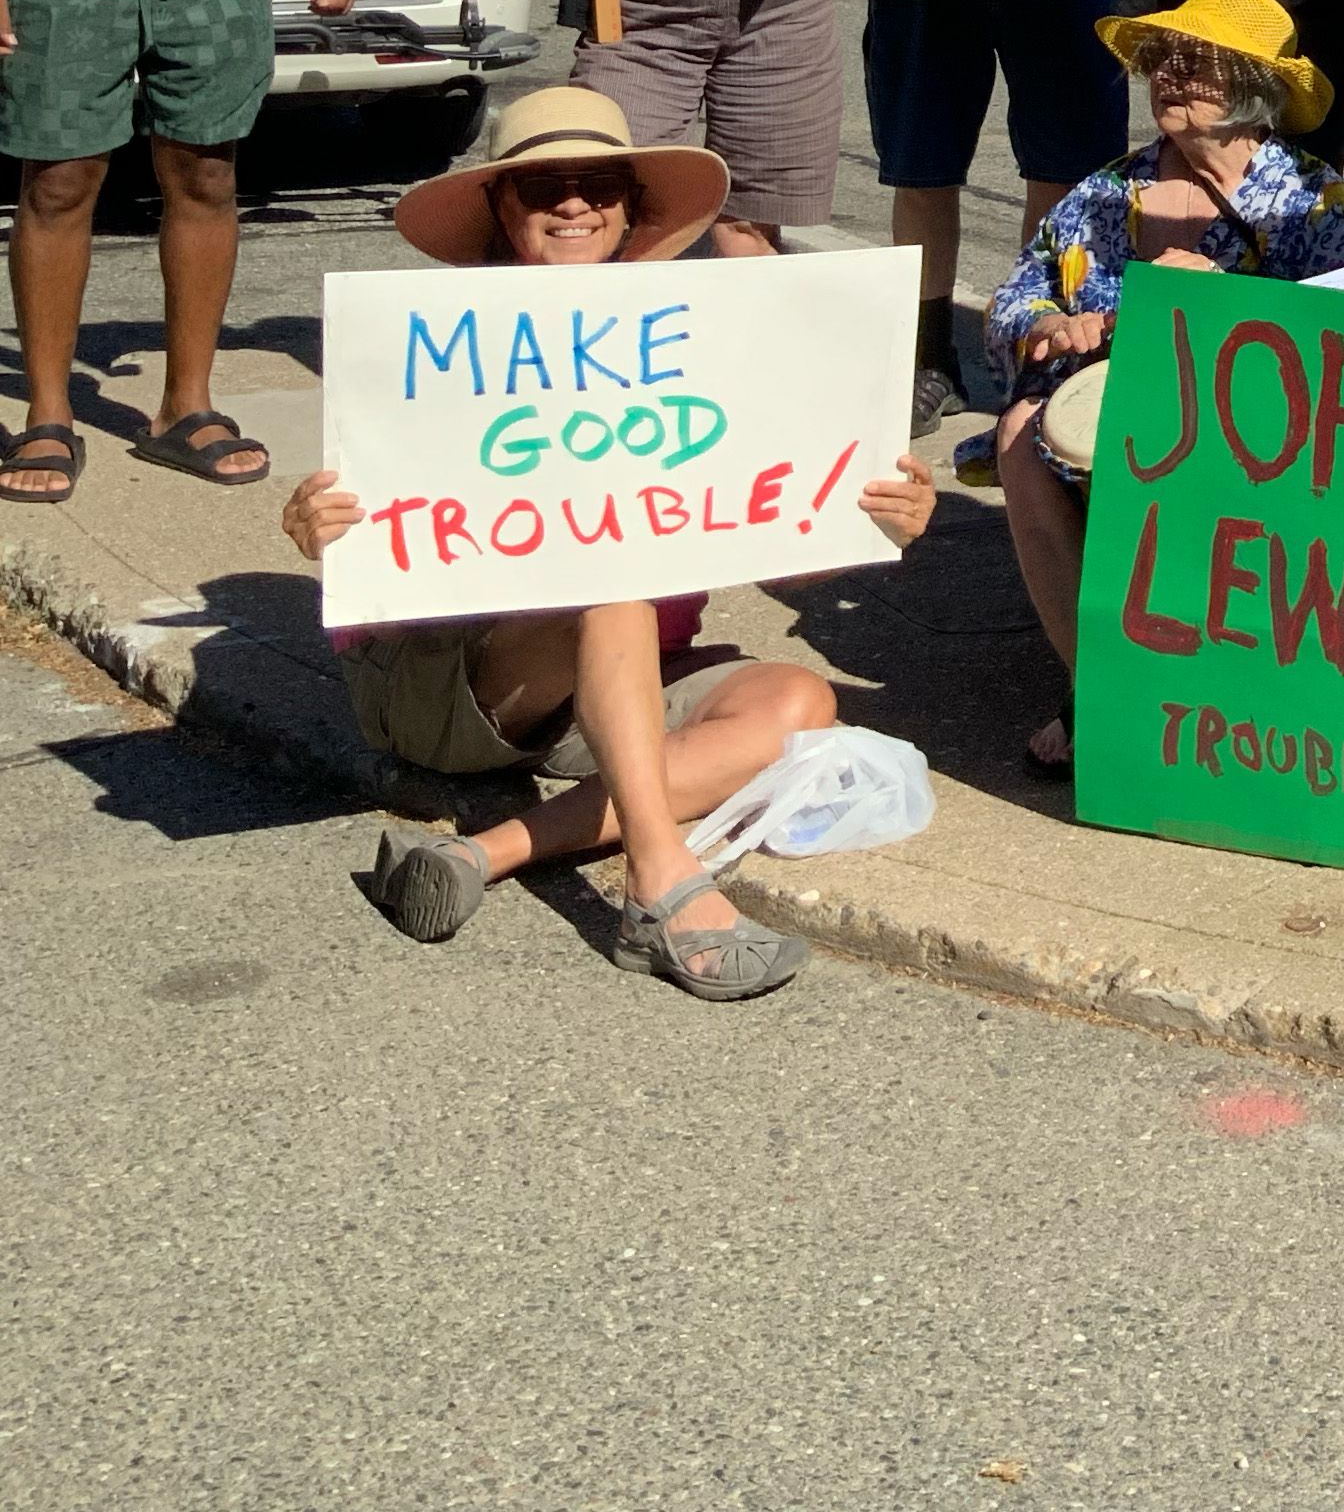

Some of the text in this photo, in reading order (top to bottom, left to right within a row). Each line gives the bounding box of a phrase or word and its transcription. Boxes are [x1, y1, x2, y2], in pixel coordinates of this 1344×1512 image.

[404, 303, 692, 401] MAKE
[480, 394, 729, 477] GOOD
[371, 439, 860, 573] TROUBLE!
